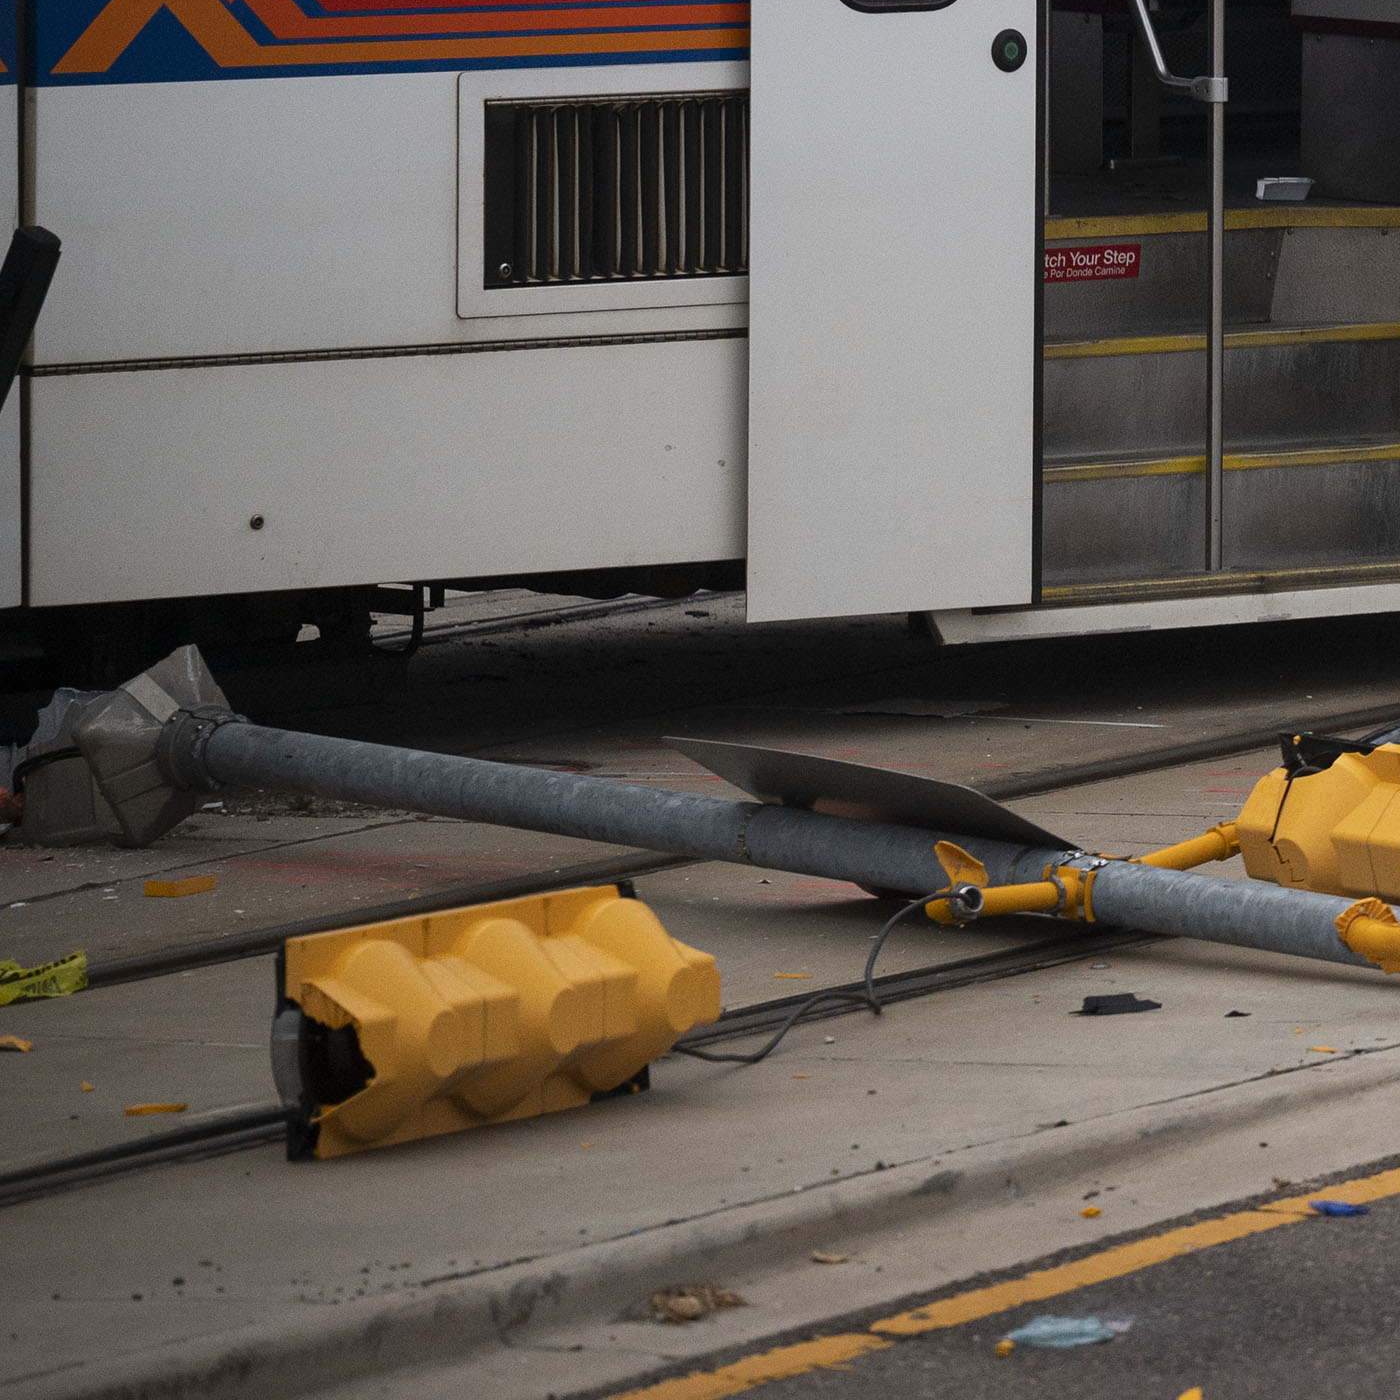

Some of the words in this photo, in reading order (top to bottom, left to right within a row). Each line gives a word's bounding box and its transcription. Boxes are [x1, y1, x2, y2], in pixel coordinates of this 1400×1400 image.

[1044, 253, 1066, 268] tch
[1069, 251, 1101, 266] Your
[1103, 249, 1136, 267] Step
[1050, 269, 1065, 279] Por
[1066, 267, 1093, 278] Donde
[1094, 265, 1126, 276] Camine
